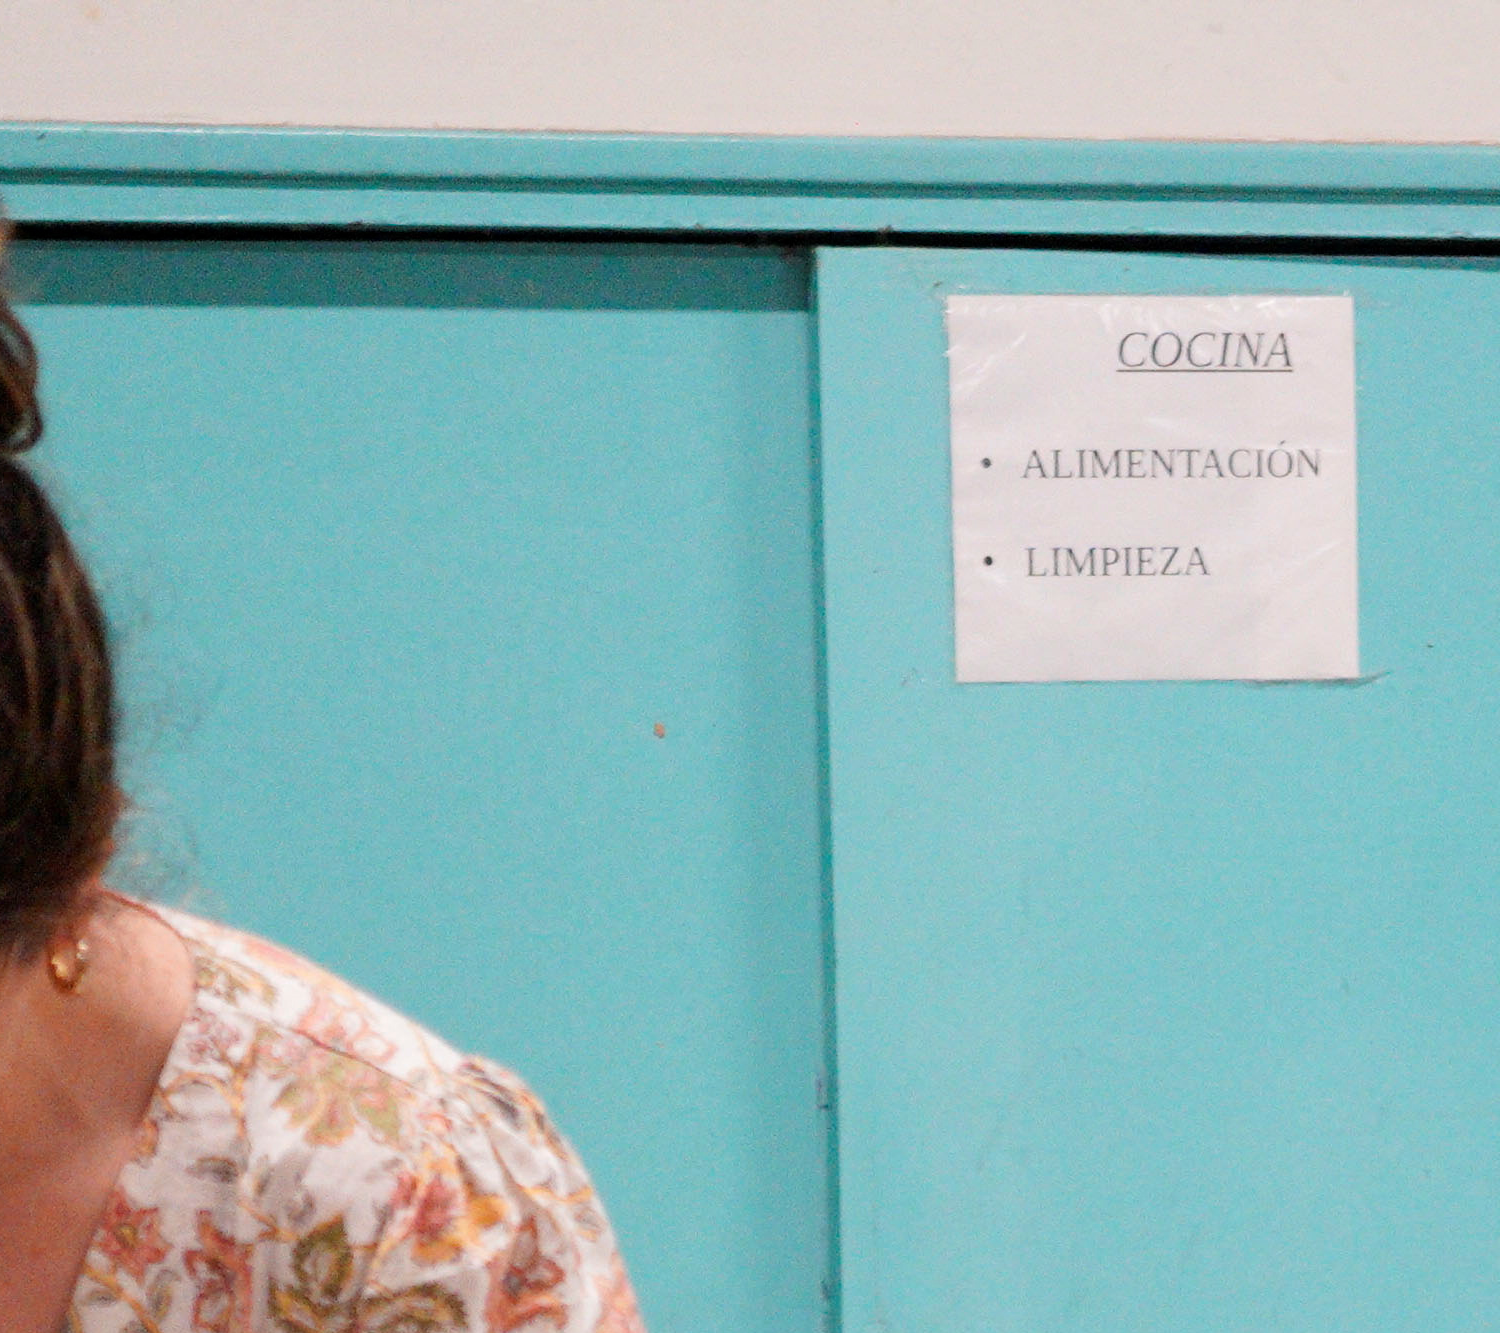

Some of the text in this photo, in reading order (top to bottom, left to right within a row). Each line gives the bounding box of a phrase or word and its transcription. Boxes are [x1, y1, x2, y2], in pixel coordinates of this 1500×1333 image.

[1116, 331, 1293, 371] COCINA
[1022, 441, 1322, 480] ALIMENTACIÓN
[1026, 547, 1211, 577] LIMPIEZA
